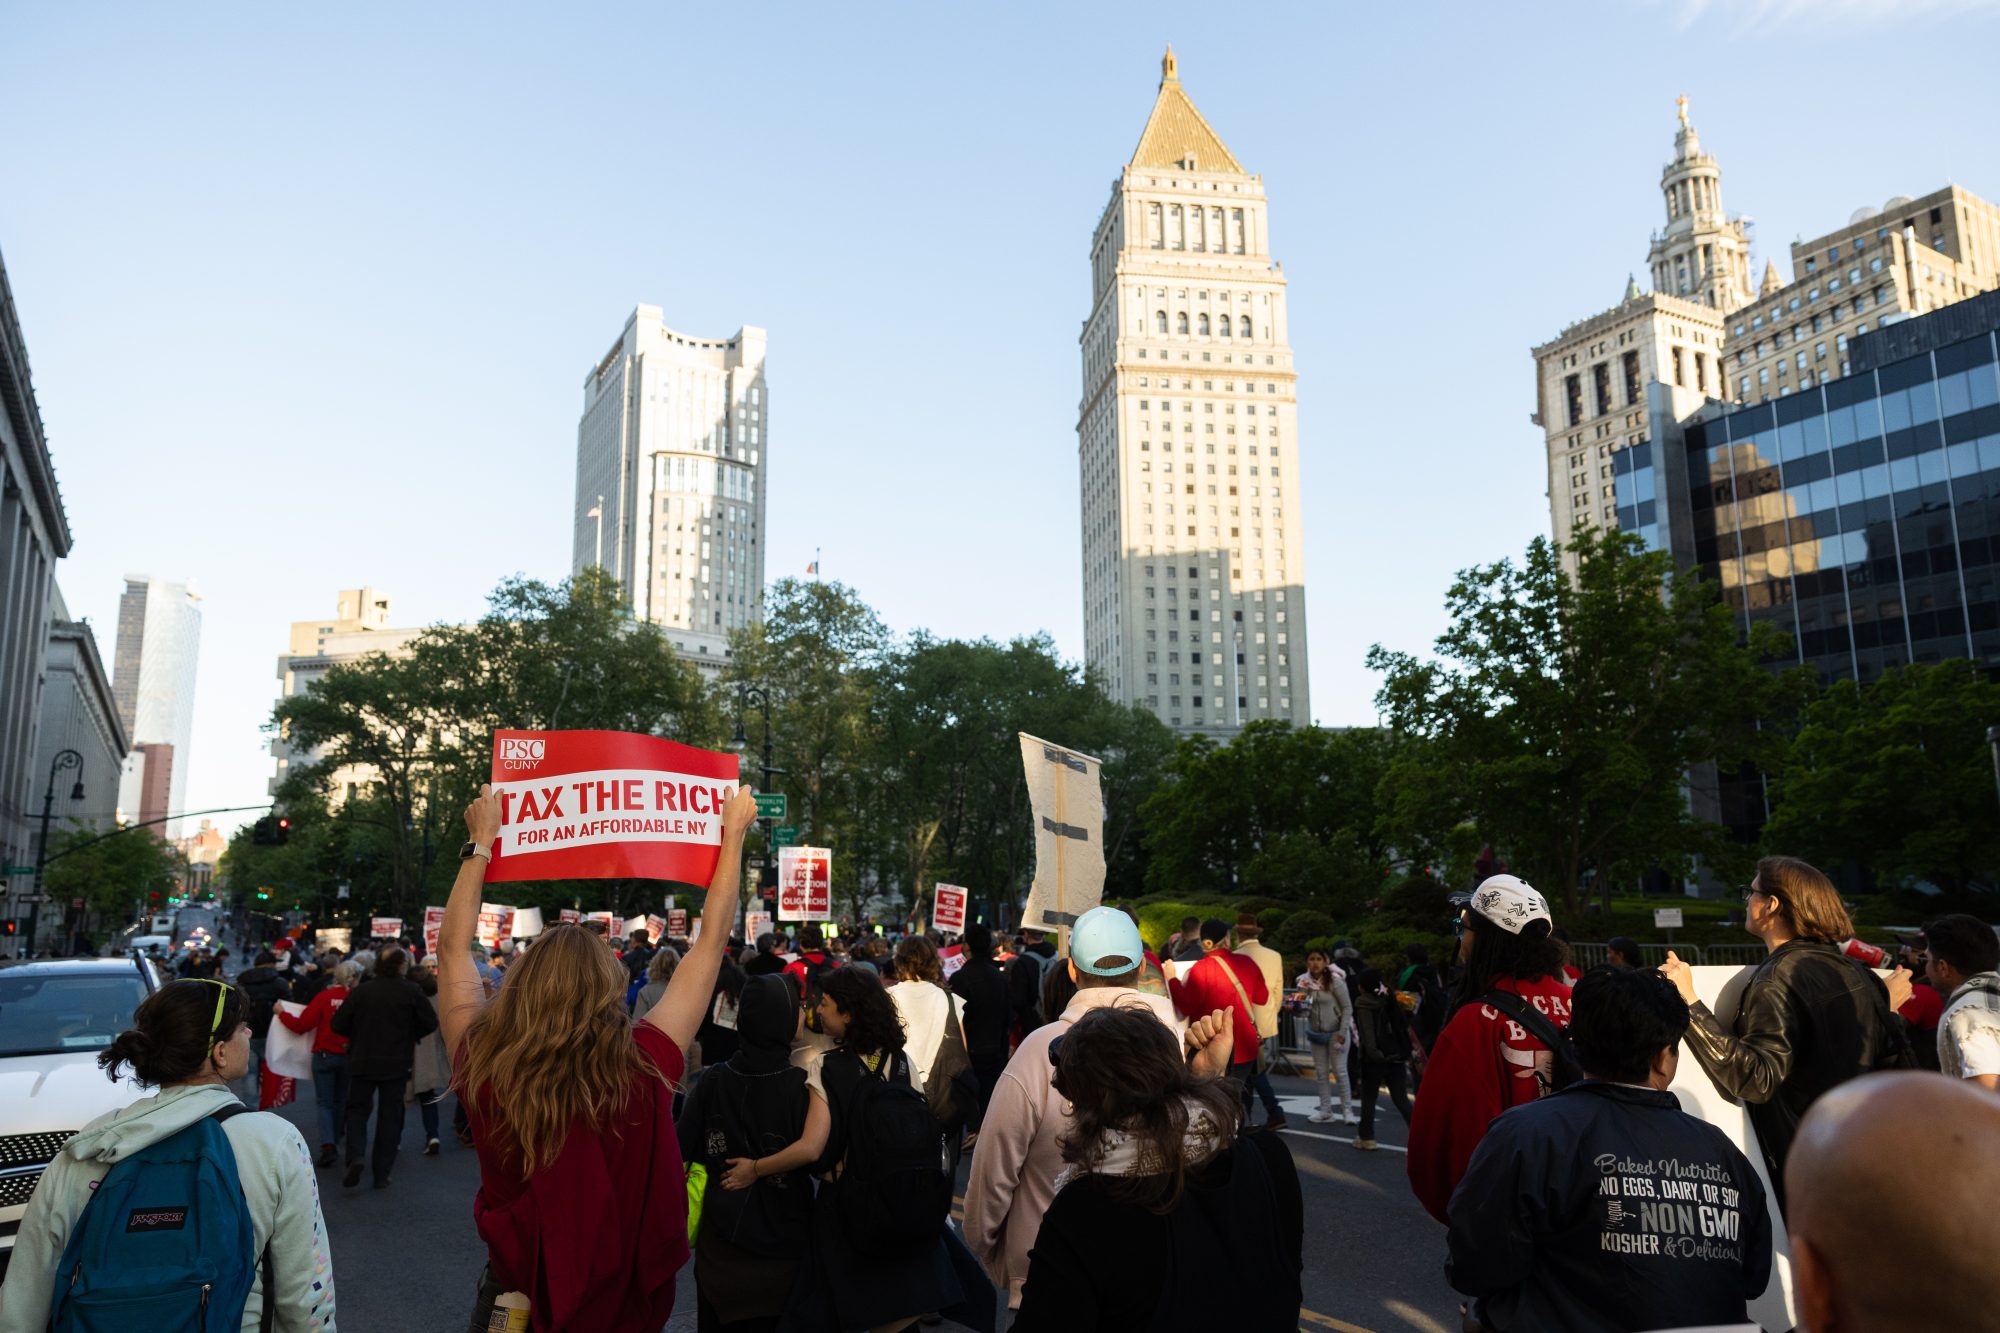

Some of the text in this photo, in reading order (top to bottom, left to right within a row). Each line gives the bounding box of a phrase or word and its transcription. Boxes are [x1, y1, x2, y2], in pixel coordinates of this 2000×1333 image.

[501, 740, 544, 759] PSC
[504, 760, 540, 770] CUNY
[501, 786, 565, 826] TAX
[572, 780, 645, 814] THE
[518, 819, 708, 846] FOR AN AFFORDABLE NY
[1594, 1153, 1731, 1184] Baked Nutritio
[1600, 1176, 1739, 1208] NO EGGS, DAIRY, OR SOY
[130, 1212, 184, 1225] JANSPORT
[1640, 1201, 1740, 1242] NON GMO
[1601, 1231, 1660, 1255] KOSHER
